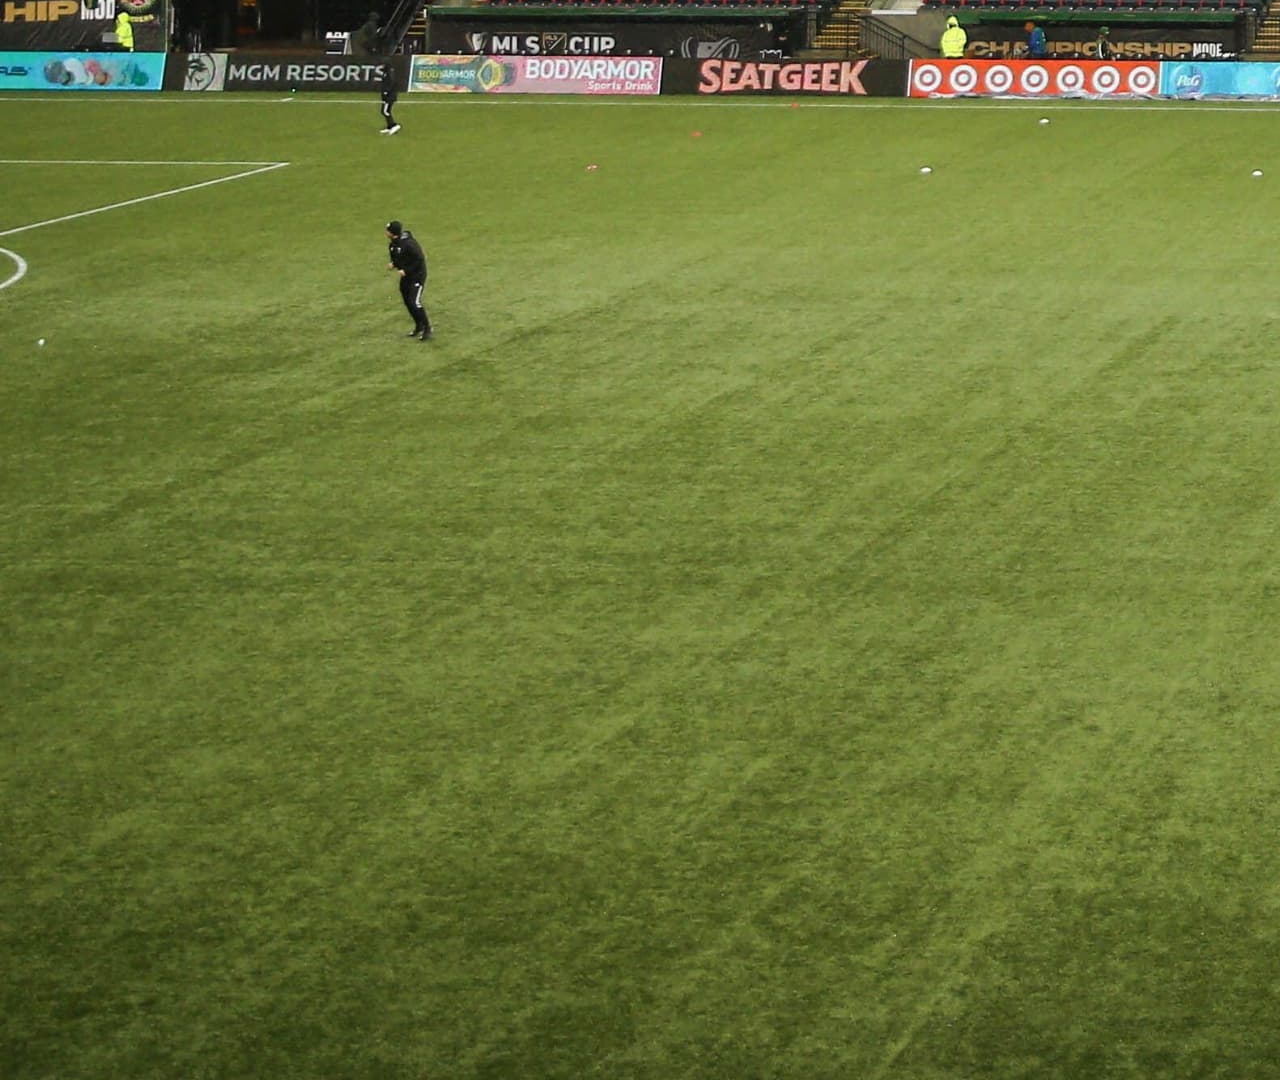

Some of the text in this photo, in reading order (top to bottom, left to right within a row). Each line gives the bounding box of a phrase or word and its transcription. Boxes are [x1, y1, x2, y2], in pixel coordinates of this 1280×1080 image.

[492, 35, 615, 54] MLS CUP
[1193, 43, 1222, 56] MODE
[229, 66, 384, 81] MGM RESORTS
[526, 59, 655, 79] BODYARMOR
[698, 59, 869, 95] SEATGEEK
[1176, 75, 1201, 87] P&G
[588, 81, 653, 91] Sports Drink
